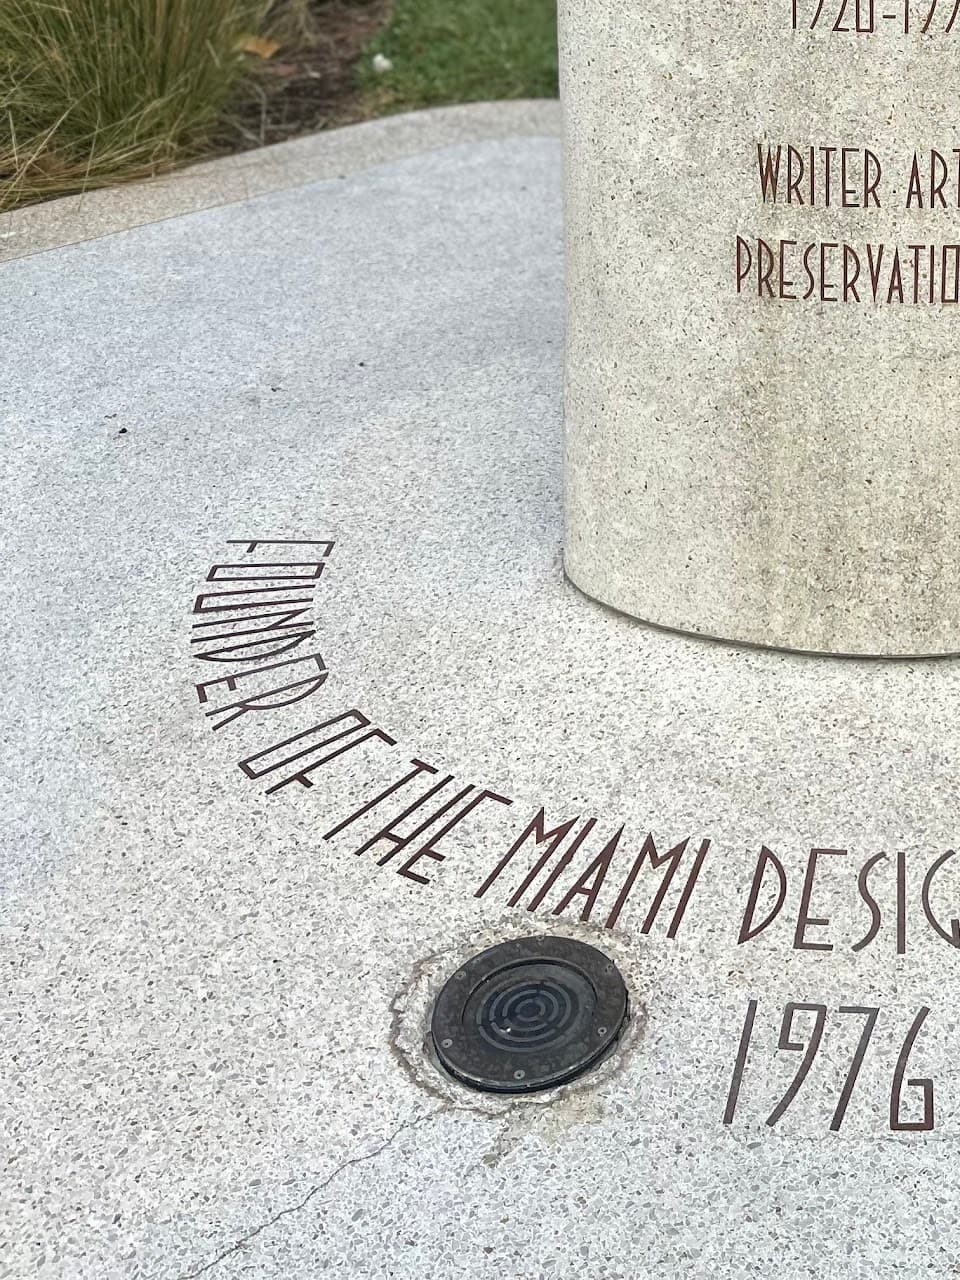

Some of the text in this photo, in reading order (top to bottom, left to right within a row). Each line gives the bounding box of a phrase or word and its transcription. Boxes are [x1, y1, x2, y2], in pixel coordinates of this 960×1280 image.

[757, 143, 882, 208] WRITER
[191, 540, 335, 730] FOUNDER
[238, 709, 397, 794] OF
[322, 758, 513, 884] THE
[474, 807, 711, 939] MIAMI
[723, 1000, 934, 1131] 1976
